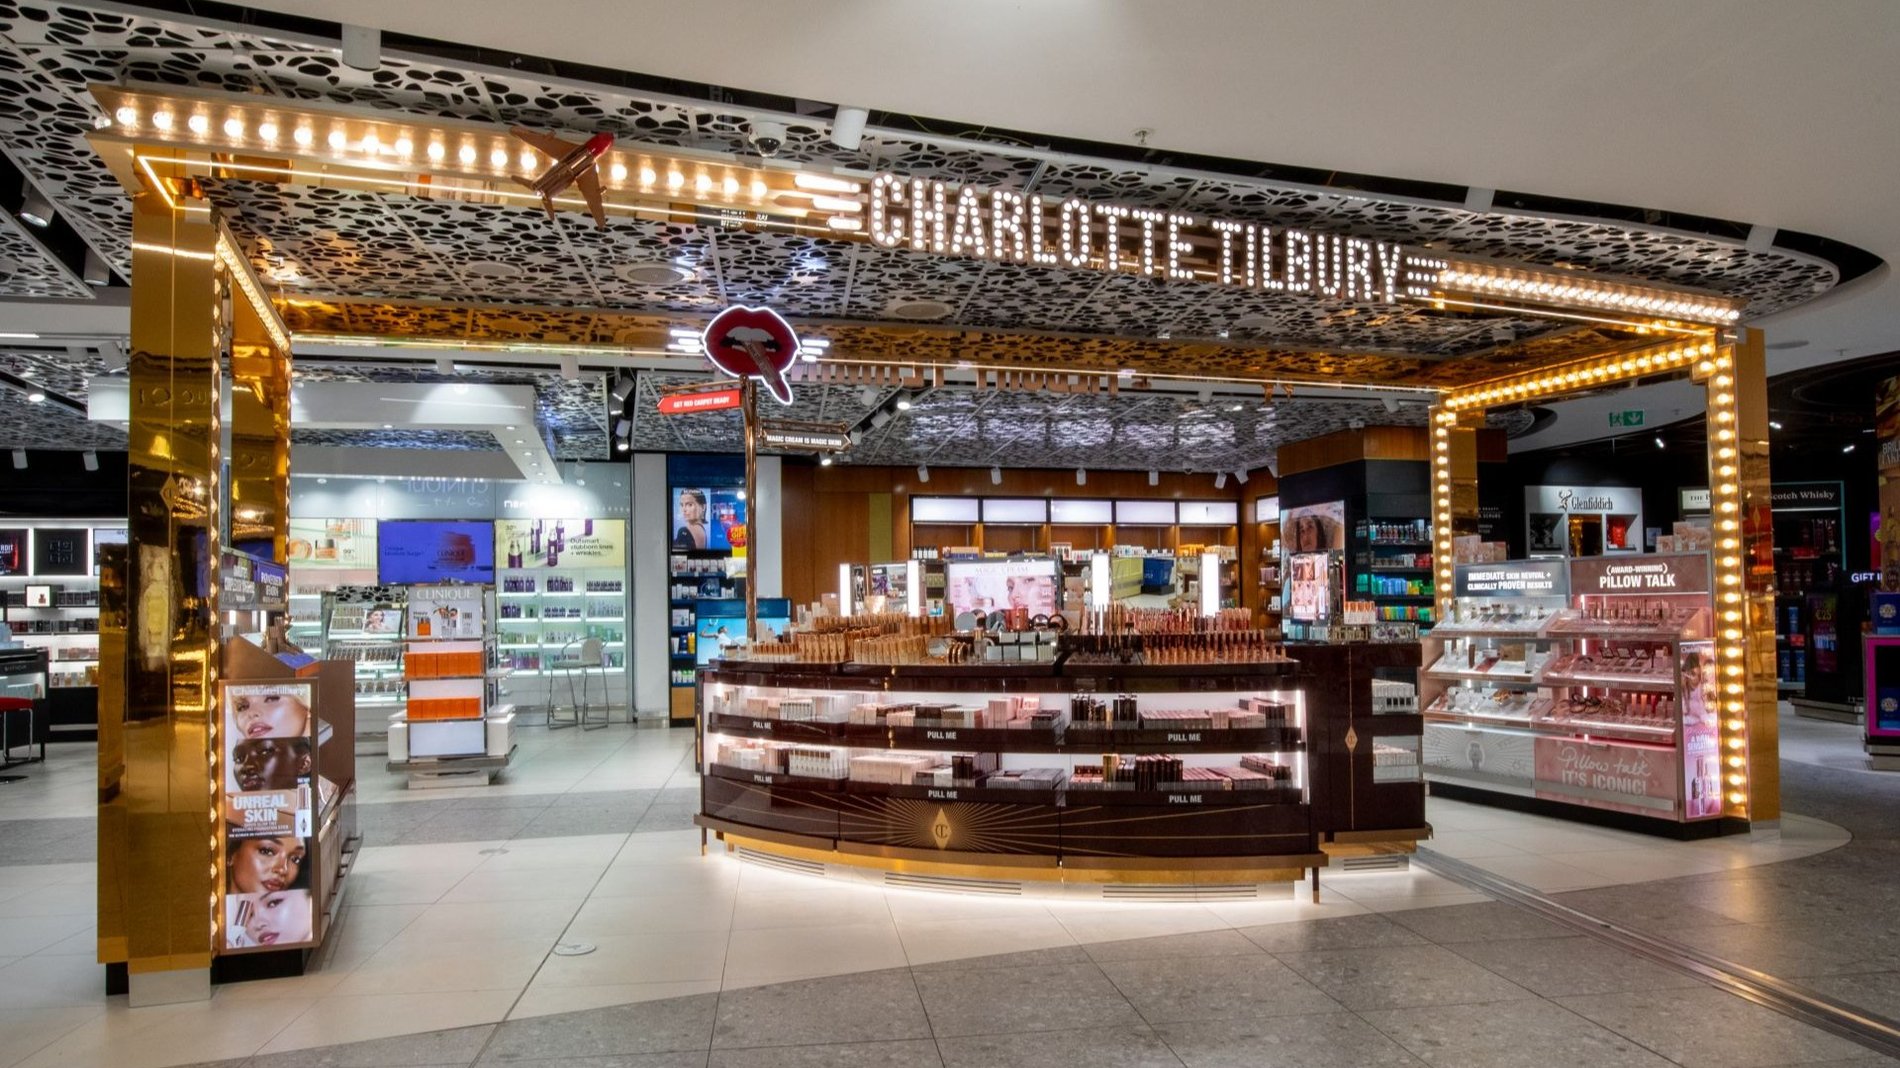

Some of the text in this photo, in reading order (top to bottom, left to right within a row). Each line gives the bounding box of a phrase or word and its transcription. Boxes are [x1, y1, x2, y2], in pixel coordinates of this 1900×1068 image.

[868, 173, 1401, 302] CHARLOTTE TILBURY
[694, 398, 712, 406] CARPET
[713, 396, 730, 405] READY
[766, 434, 784, 443] MAGIC
[784, 435, 803, 444] CREAM
[810, 437, 827, 445] MAGIC
[1770, 489, 1835, 500] cotch Whisky
[1571, 496, 1613, 511] Glenfiddich
[1606, 562, 1668, 575] (AWARD-WINNING)
[1468, 571, 1505, 582] IMMEDIATE
[1506, 572, 1520, 580] SKIN
[1521, 571, 1545, 580] REVIVAL
[1599, 573, 1676, 589] PILLOW TALK
[1851, 572, 1874, 583] GIFT
[1467, 580, 1553, 591] CLINICALLY PROVEN RESULTS
[416, 588, 473, 600] CLINIQUE
[752, 721, 772, 730] PULL ME
[927, 731, 957, 740] PULL ME
[1168, 733, 1201, 741] PULL ME
[1556, 746, 1652, 777] Pillow talk
[753, 775, 773, 783] PULL ME
[1561, 769, 1647, 796] IT'S ICONIC!
[928, 790, 958, 799] PULL ME
[1168, 795, 1203, 803] PULL ME
[233, 794, 288, 810] UNREAL
[244, 809, 278, 823] SKIN
